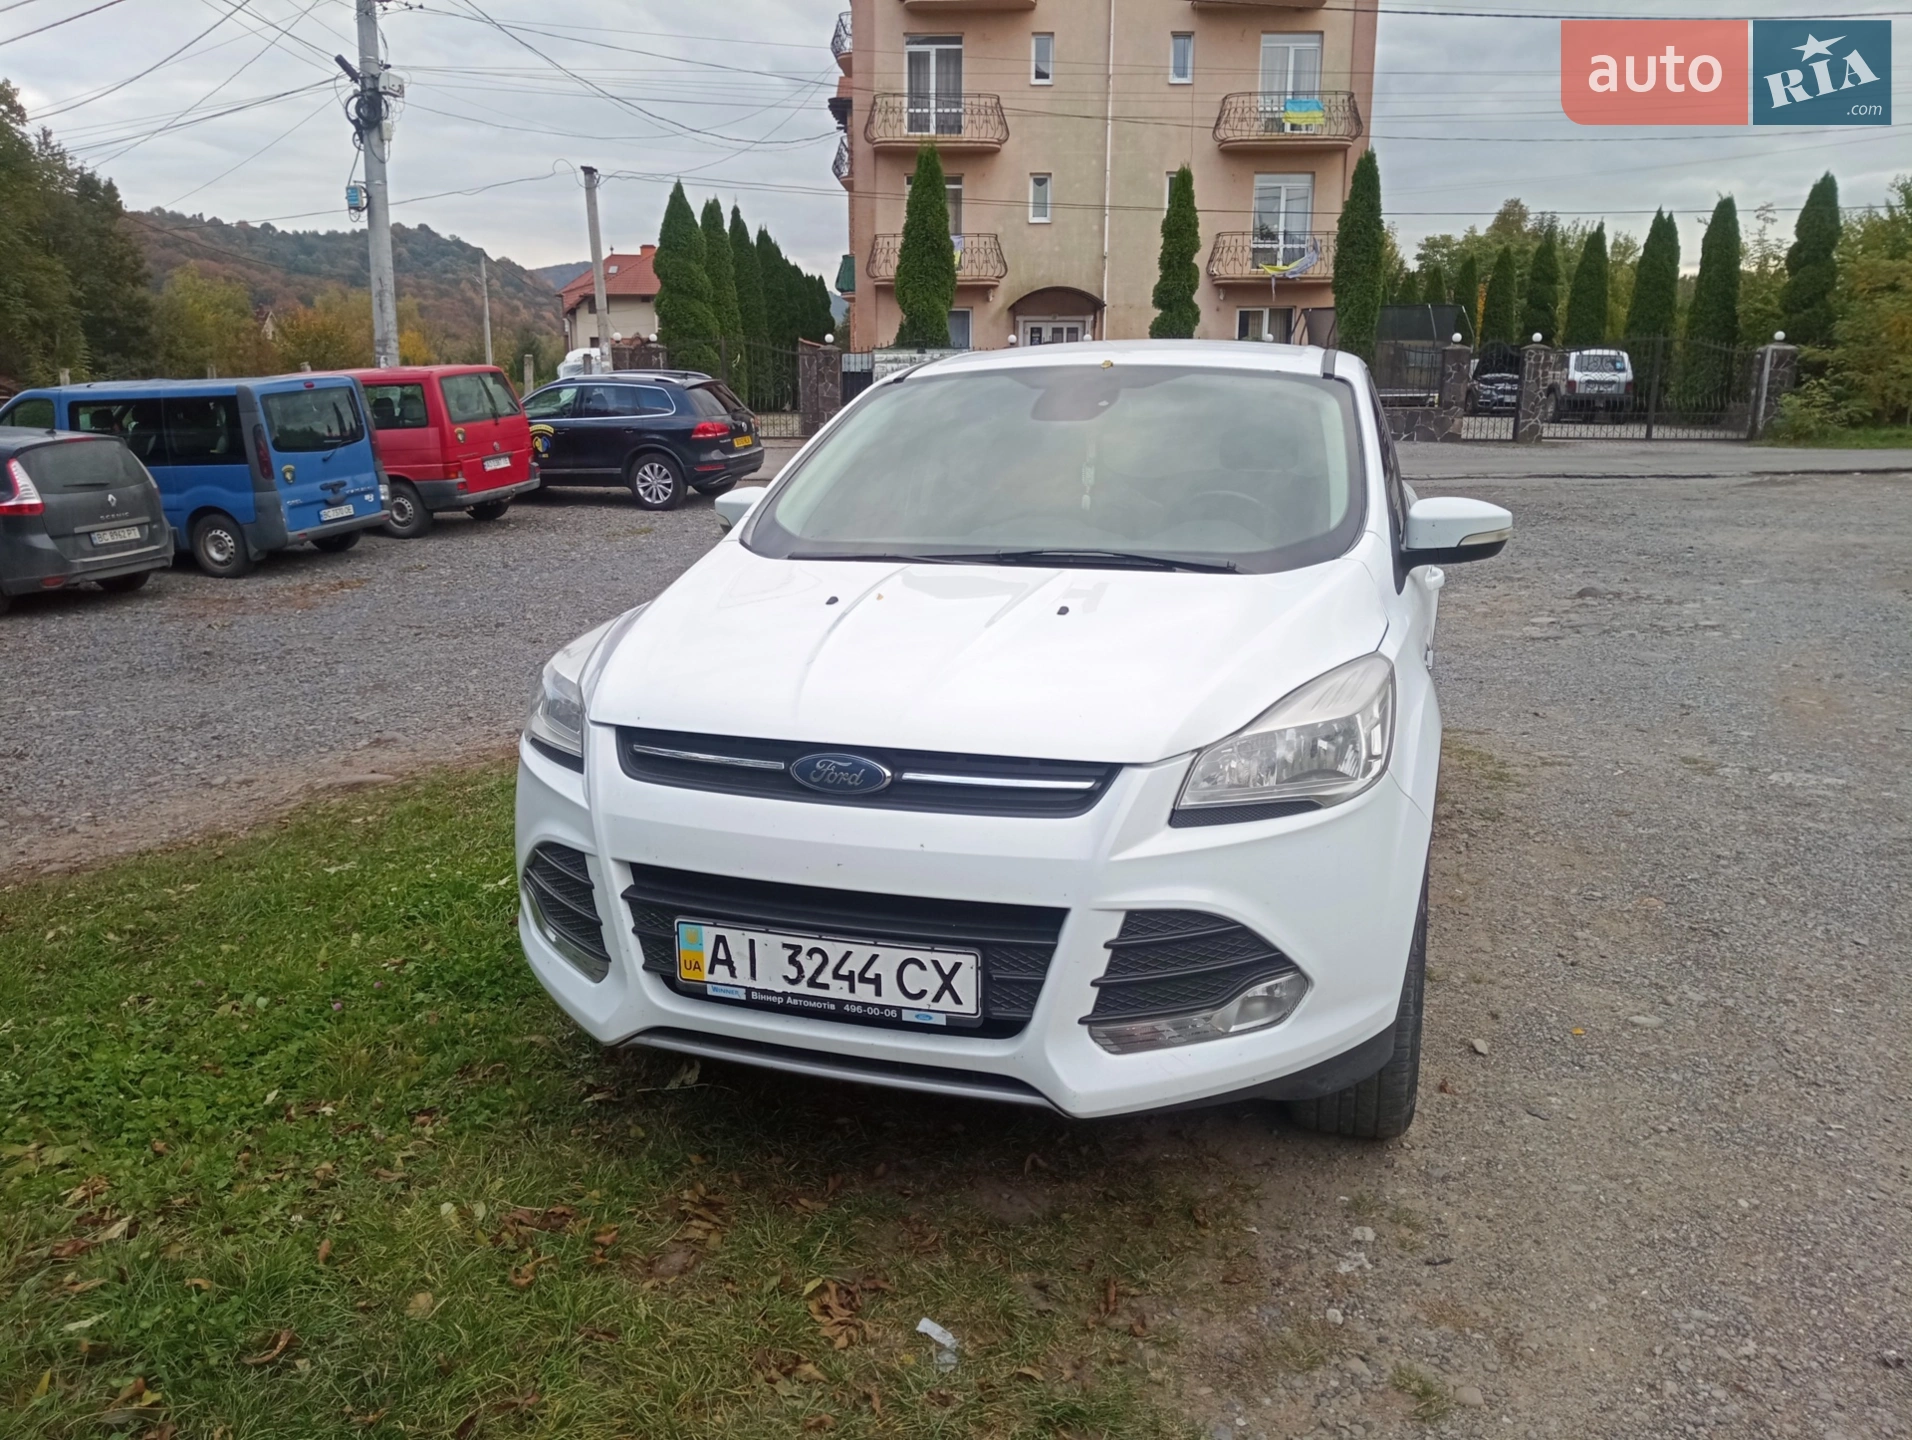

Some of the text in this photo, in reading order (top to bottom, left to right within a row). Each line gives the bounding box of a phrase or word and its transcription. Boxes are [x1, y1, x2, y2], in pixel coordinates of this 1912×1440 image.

[97, 532, 109, 543] BC
[810, 759, 866, 786] Ford
[684, 959, 702, 972] UA
[708, 934, 963, 1006] AI 3244 CX
[751, 991, 784, 1005] Віннер
[786, 996, 836, 1011] Автомотів
[843, 1003, 898, 1018] 496-00-06
